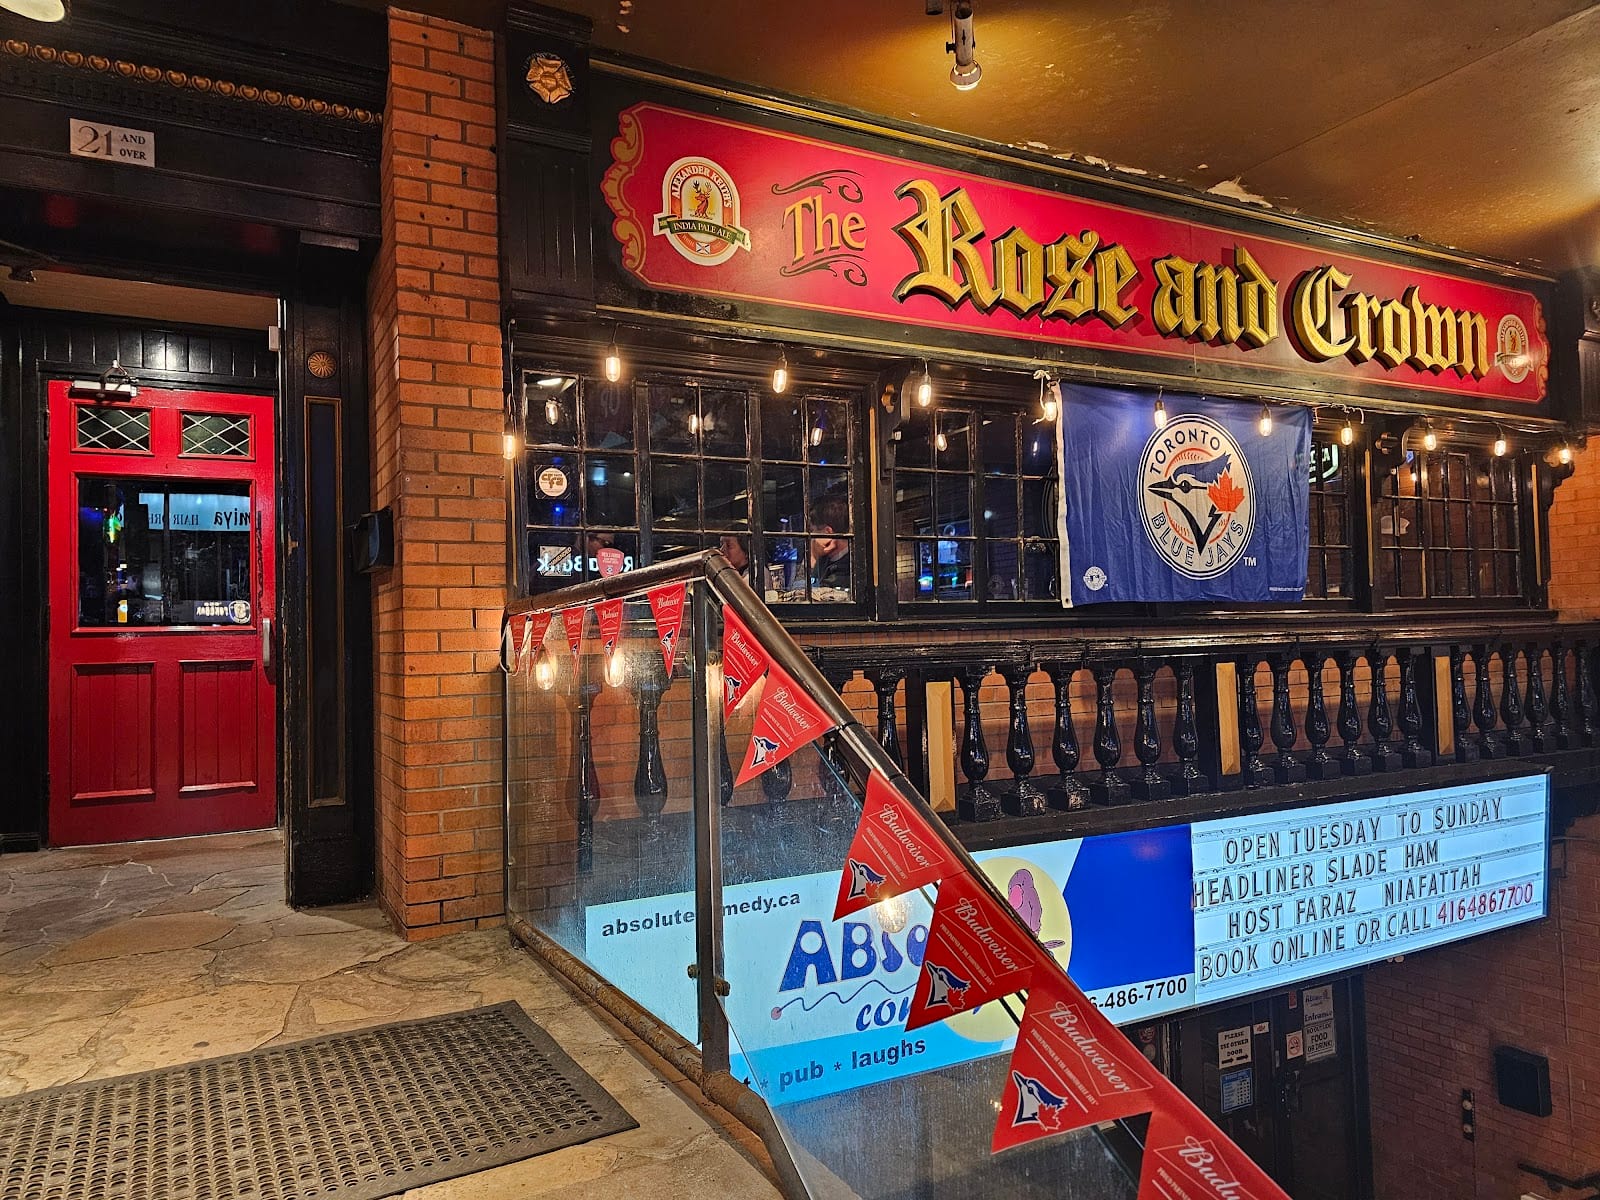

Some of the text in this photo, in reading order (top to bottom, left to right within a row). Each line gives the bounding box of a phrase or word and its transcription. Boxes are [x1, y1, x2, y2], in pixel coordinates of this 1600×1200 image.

[78, 125, 113, 157] 21
[119, 148, 147, 160] OVER
[120, 133, 146, 145] AND
[671, 164, 733, 209] ALEXANDER KEITH'S
[673, 220, 697, 232] INDIA
[698, 222, 718, 237] PALE
[717, 227, 732, 240] ALE
[782, 179, 1490, 382] The Rose and Crown
[1150, 428, 1221, 476] TORONTO
[1151, 511, 1245, 567] BLUE JAYS
[1243, 557, 1257, 567] TM
[731, 629, 759, 667] Budweiser
[773, 686, 811, 730] Budweiser
[879, 803, 930, 868] Budweiser
[1225, 797, 1502, 865] OPEN TUESDAY TO SUNDAY
[1193, 839, 1439, 908] HEADLINER SLADE HAM
[602, 893, 801, 937] absolutemedy.ca
[1229, 862, 1481, 938] HOST FARAZ NIAFATTAH
[954, 897, 1019, 972] Budweiser
[1200, 882, 1534, 982] BOOK ONLINE OR CALL 4164867700
[1050, 1001, 1131, 1092] Budweiser
[1224, 1031, 1245, 1040] PLEASE
[1226, 1048, 1243, 1057] DOOR
[1311, 1032, 1328, 1044] FOOD
[779, 1039, 926, 1092] pub laughs
